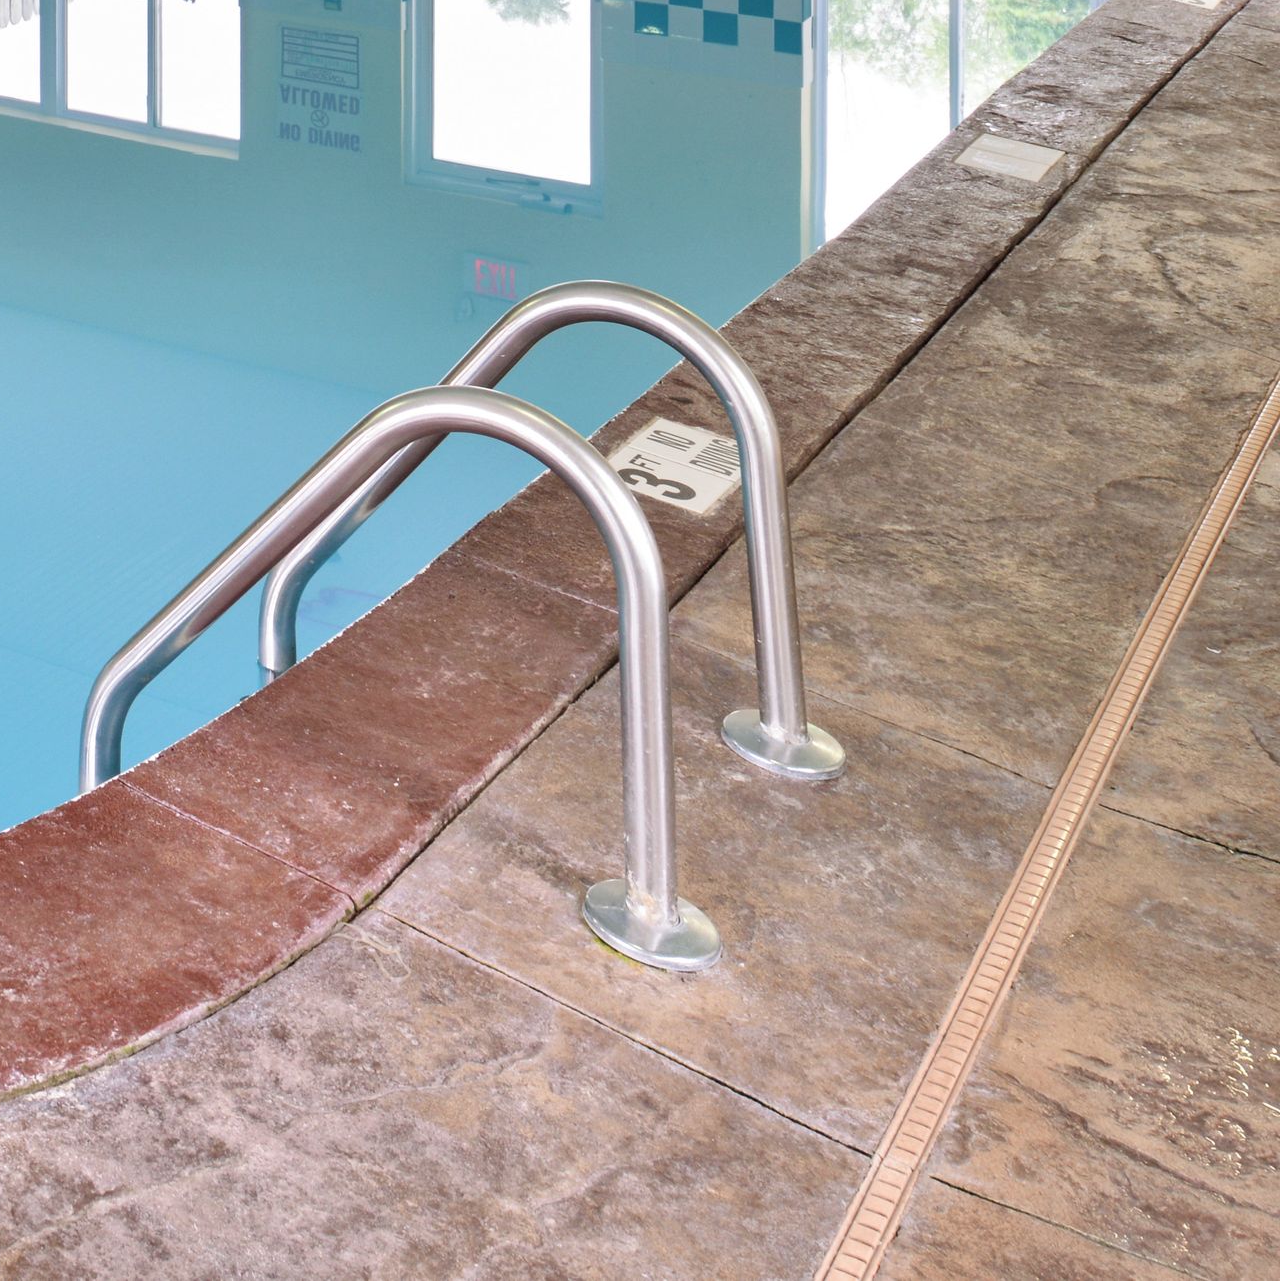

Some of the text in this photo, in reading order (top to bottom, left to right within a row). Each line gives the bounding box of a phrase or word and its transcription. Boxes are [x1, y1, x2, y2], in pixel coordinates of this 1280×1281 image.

[646, 430, 696, 452] NO
[617, 454, 696, 501] 3 FT
